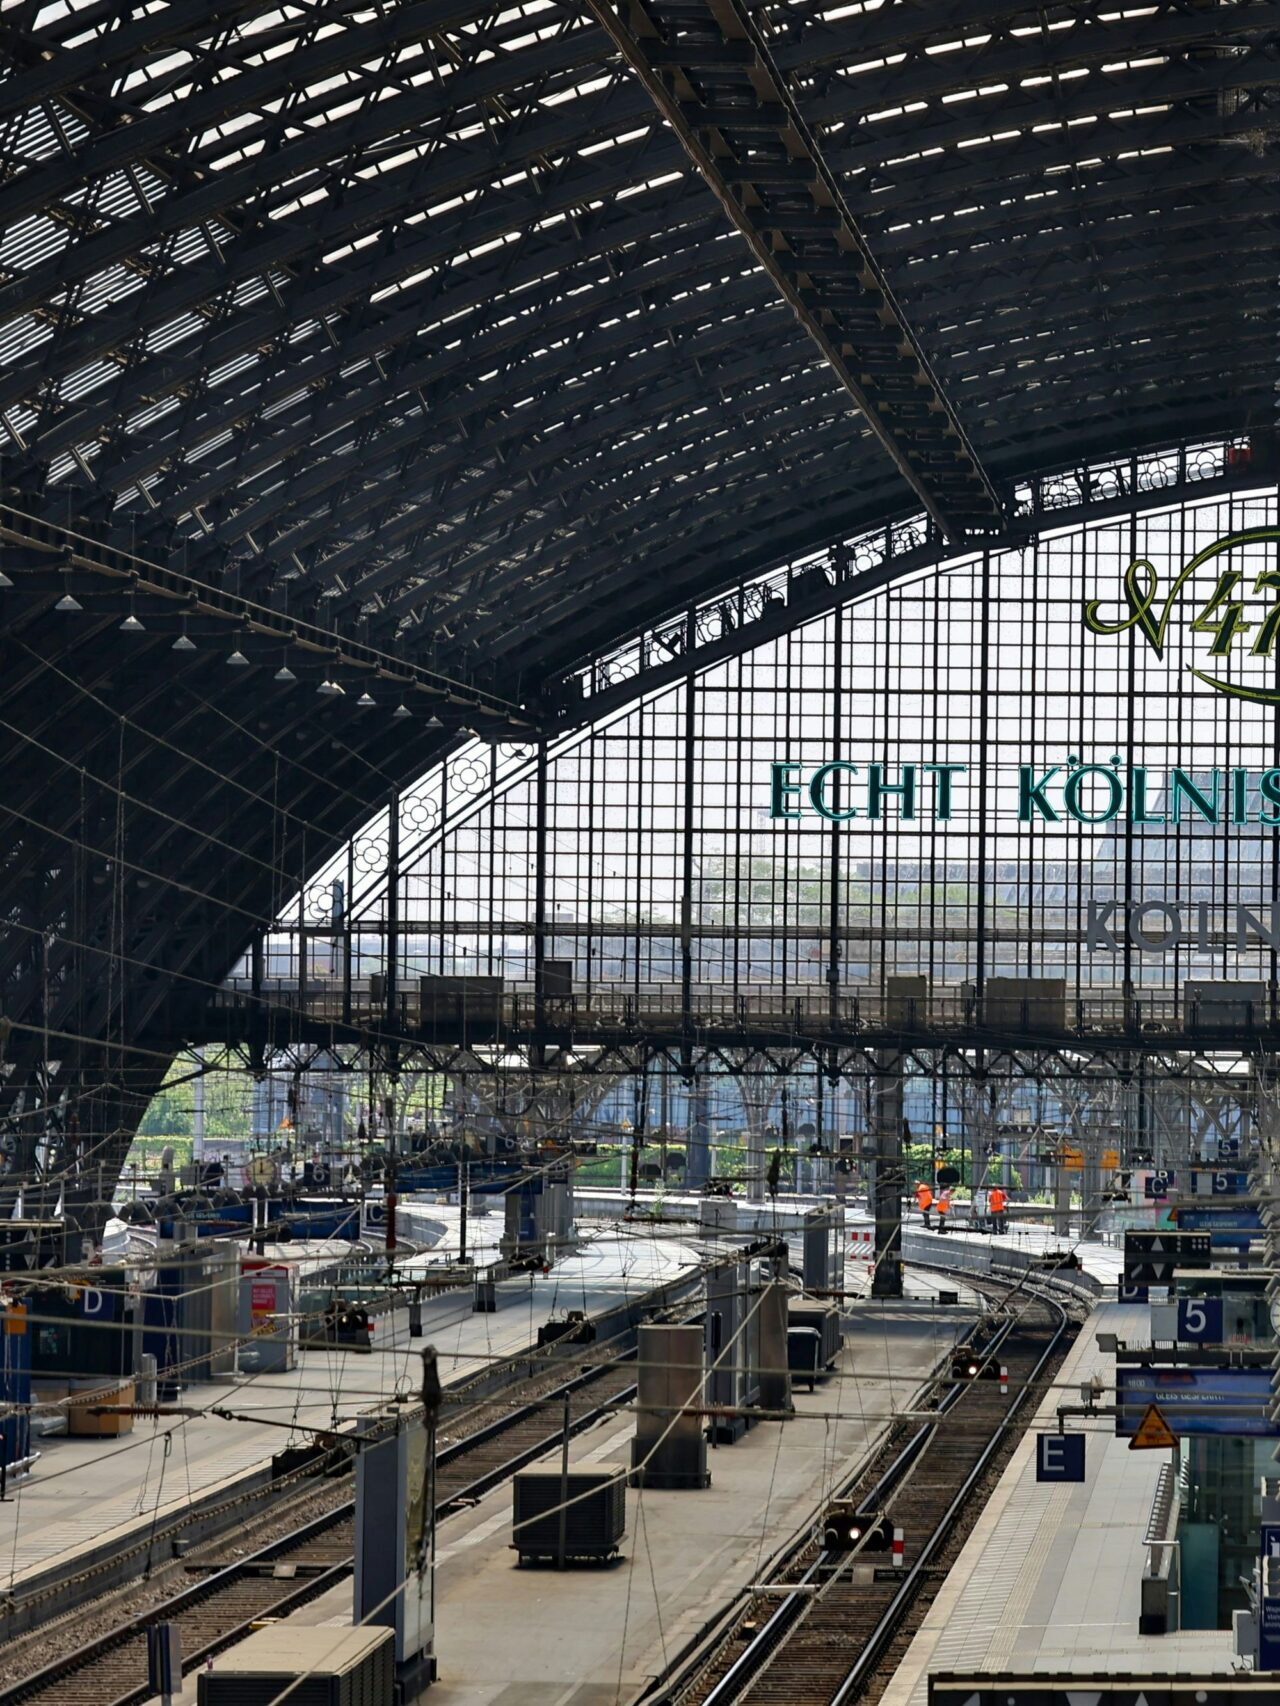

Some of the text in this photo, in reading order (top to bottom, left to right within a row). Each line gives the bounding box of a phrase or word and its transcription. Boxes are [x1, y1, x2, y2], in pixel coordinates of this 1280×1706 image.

[771, 762, 966, 821] ECHT
[1086, 899, 1280, 954] KÖLN
[505, 1134, 515, 1149] 6
[1221, 1140, 1231, 1155] 5
[313, 1165, 325, 1182] 6
[1216, 1172, 1228, 1191] 5
[1152, 1177, 1164, 1194] C
[84, 1287, 103, 1313] D
[1185, 1299, 1207, 1333] 5
[1043, 1435, 1065, 1471] E
